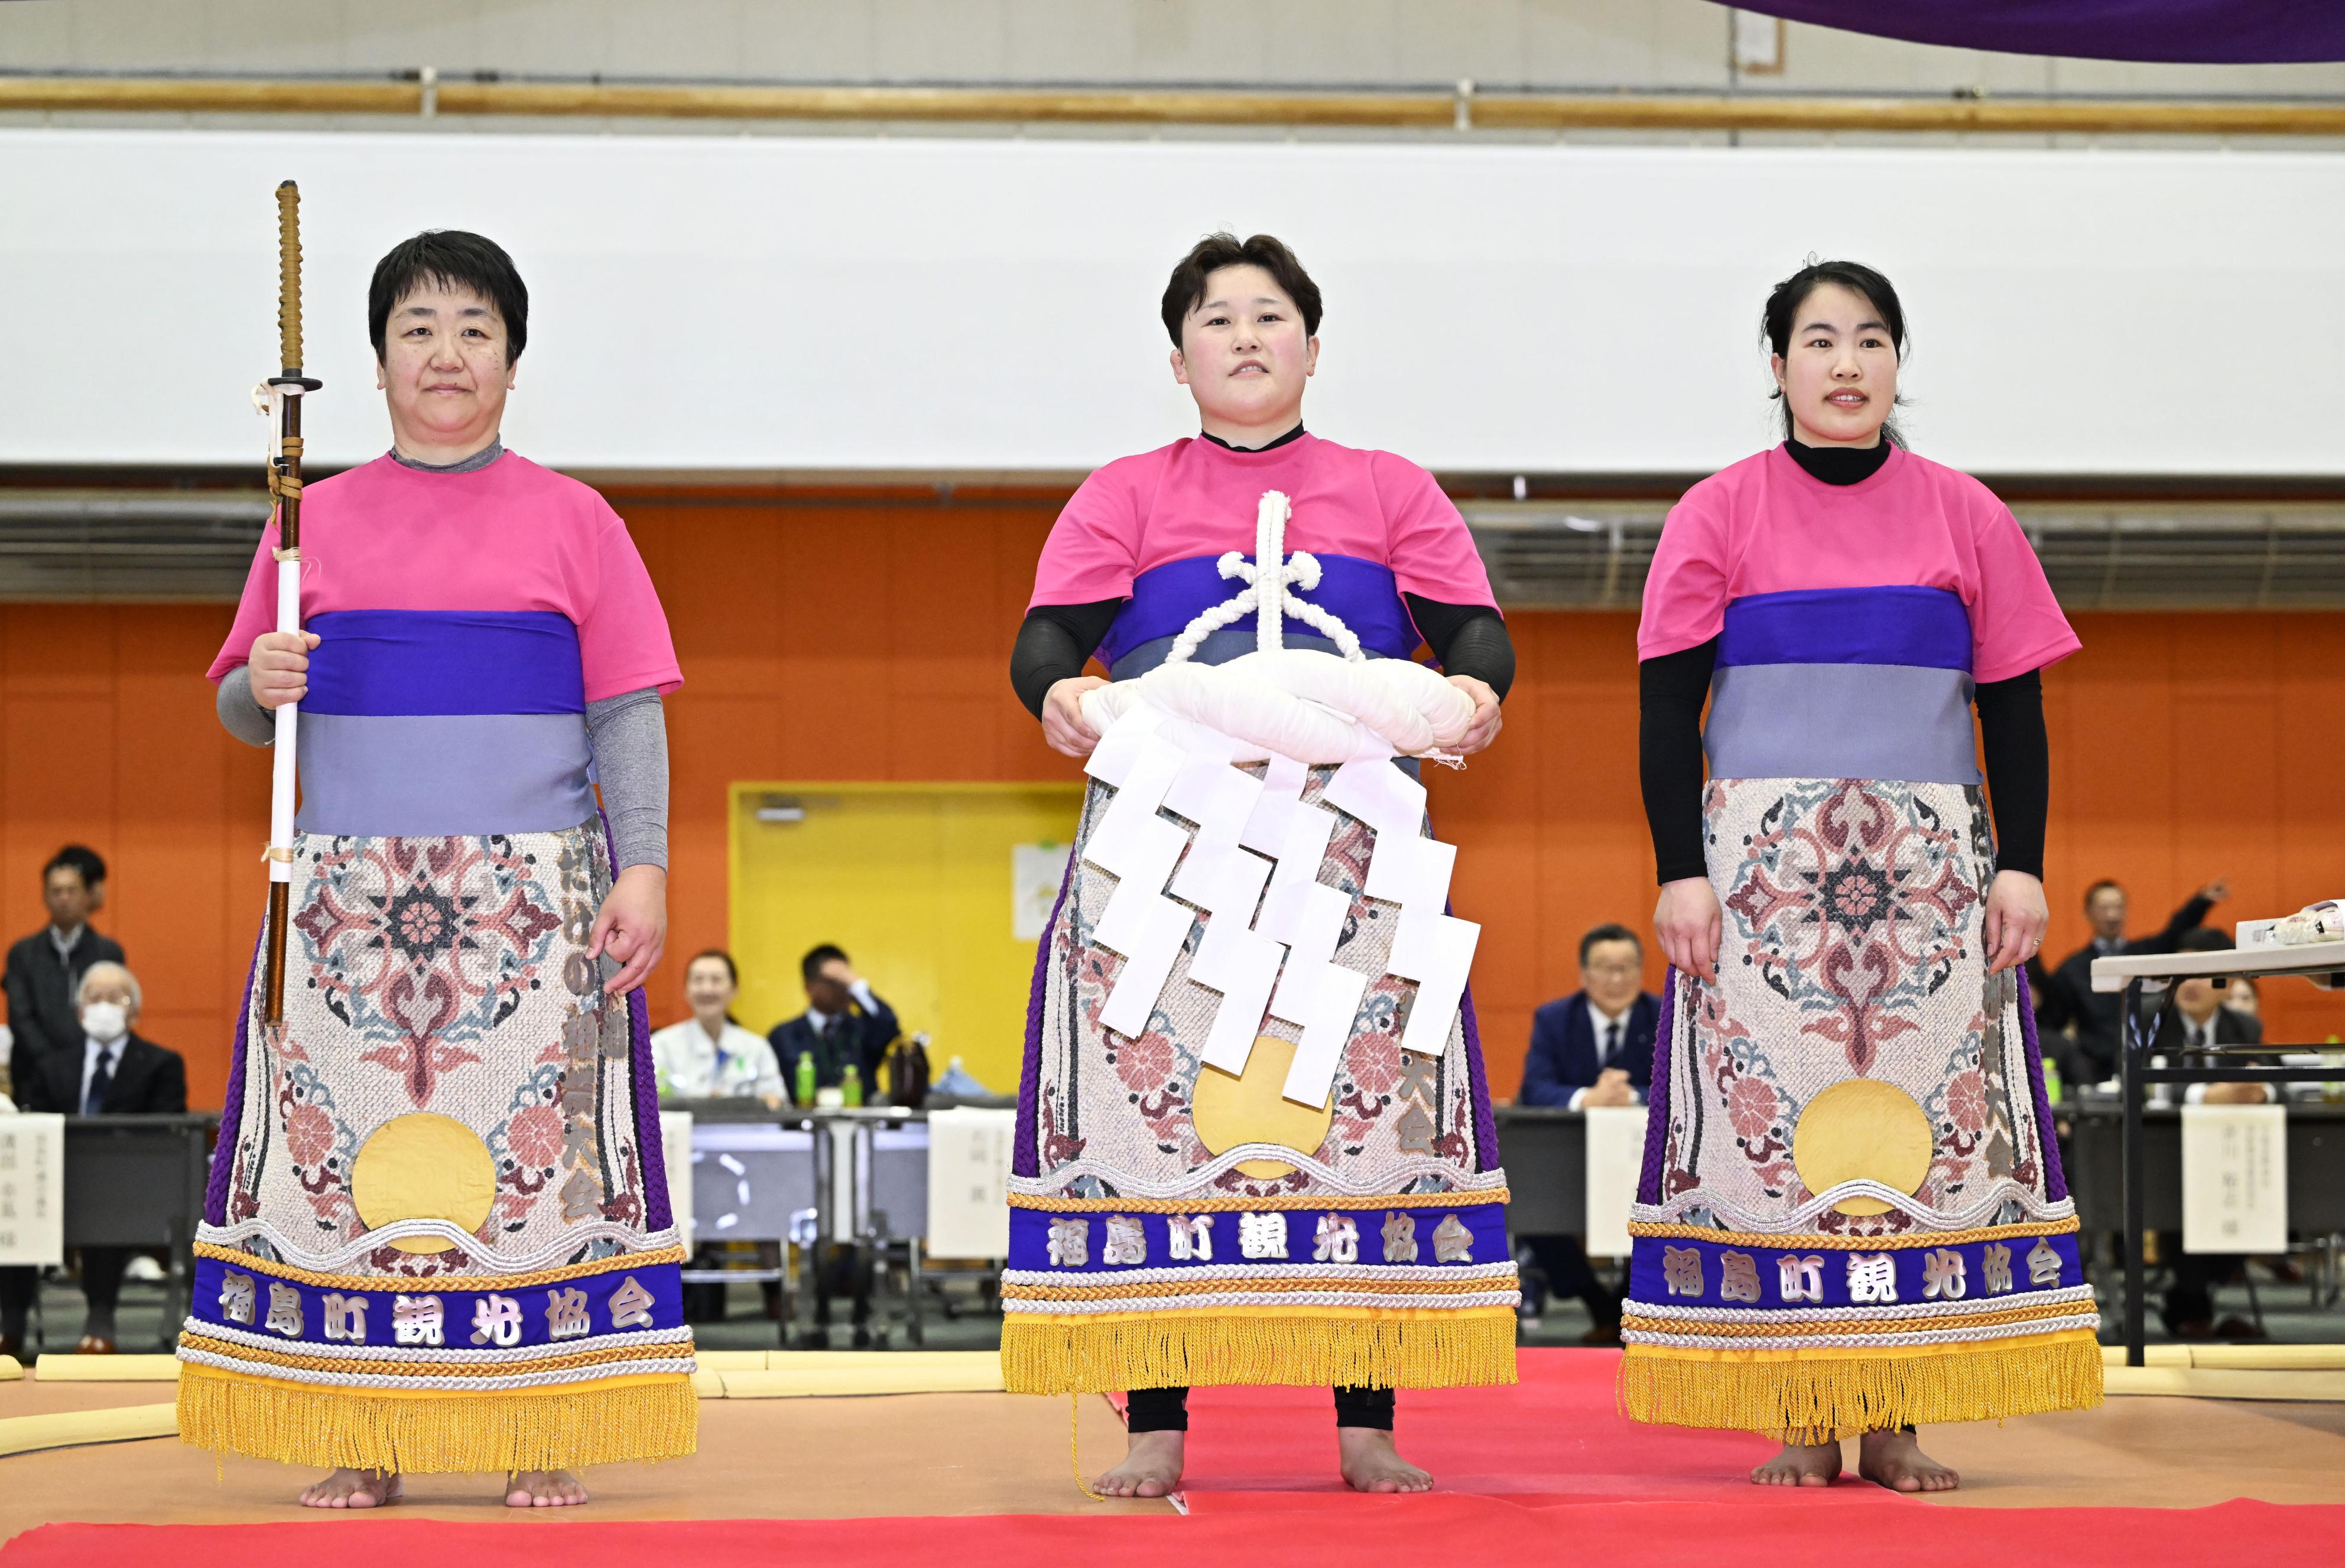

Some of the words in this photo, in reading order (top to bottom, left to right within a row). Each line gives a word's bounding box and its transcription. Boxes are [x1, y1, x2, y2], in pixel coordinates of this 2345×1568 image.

[1047, 1211, 1474, 1267] 福島町観光協会
[1662, 1236, 2062, 1305] 福島町観光協会
[217, 1268, 657, 1348] 福島町観光協会
